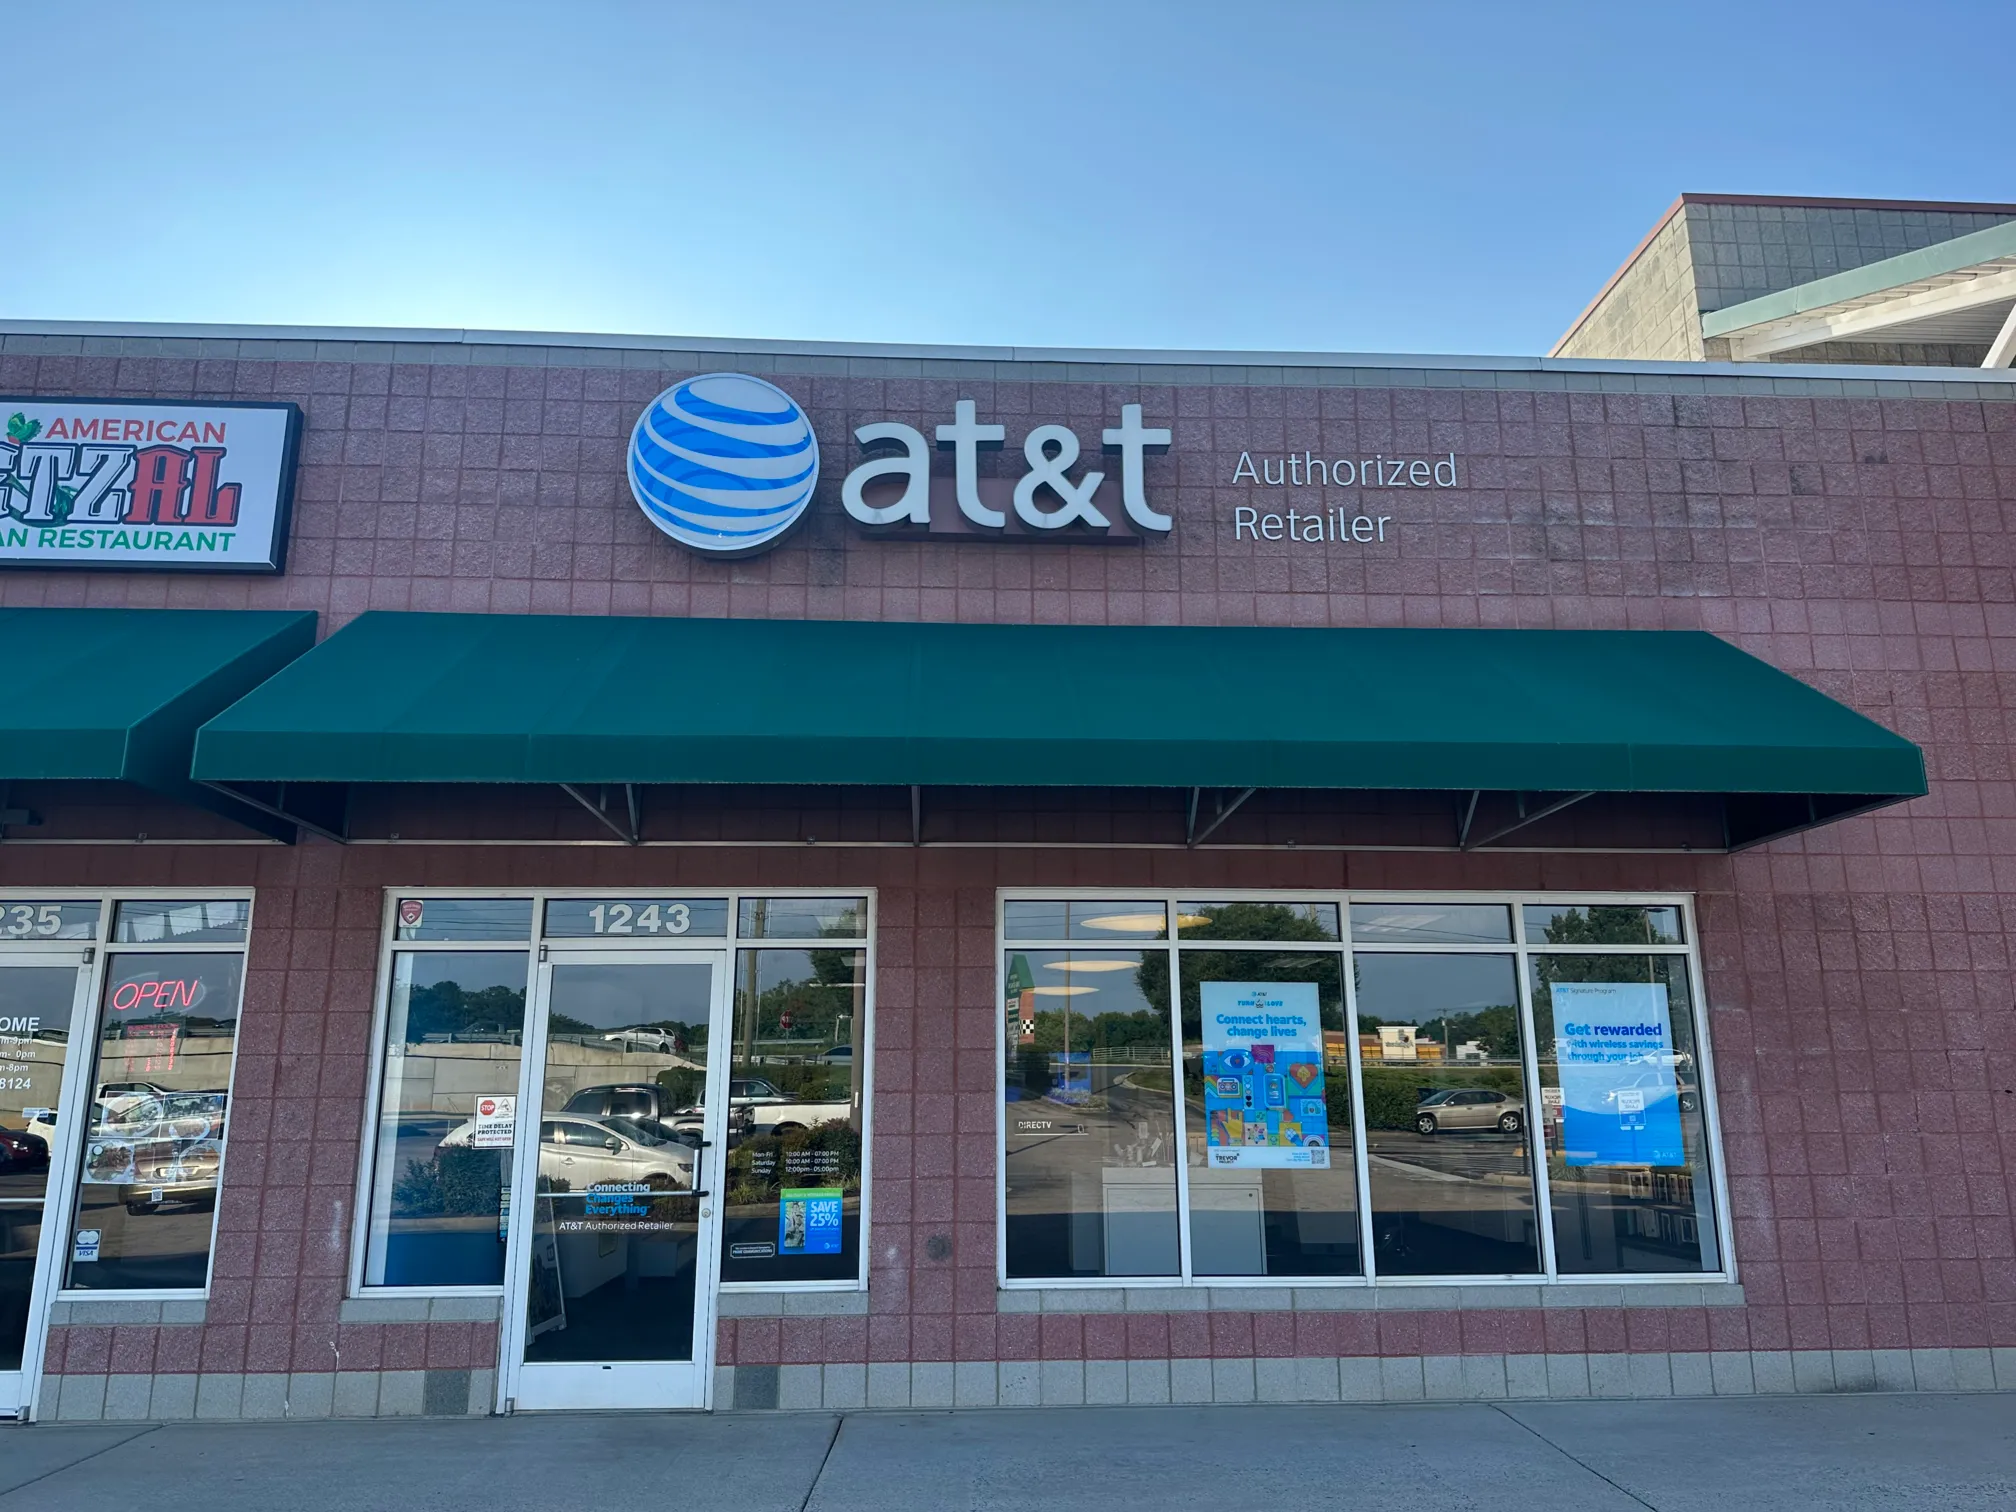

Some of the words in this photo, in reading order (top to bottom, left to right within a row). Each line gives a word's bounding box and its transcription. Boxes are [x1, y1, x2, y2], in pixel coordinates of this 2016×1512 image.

[45, 417, 227, 443] AMERICAN
[1232, 450, 1457, 487] Authorized
[1235, 506, 1392, 543] Retailer
[38, 528, 236, 552] RESTAURANT
[0, 905, 62, 935] 35
[589, 903, 691, 934] 1243
[113, 980, 198, 1010] OPEN
[1216, 1013, 1264, 1025] Connect
[1265, 1013, 1307, 1027] hearts,
[1226, 1025, 1269, 1039] change
[1270, 1025, 1297, 1037] lives
[1564, 1022, 1592, 1036] Get
[1594, 1022, 1662, 1036] rewarded
[1589, 1039, 1627, 1049] wireless
[1628, 1040, 1664, 1050] savings
[1568, 1051, 1605, 1062] through
[1605, 1052, 1628, 1062] your
[1018, 1121, 1052, 1129] DIRECTV
[587, 1182, 650, 1193] Connecting
[586, 1193, 634, 1206] Changes
[585, 1204, 648, 1217] Everything
[810, 1201, 838, 1213] SAVE
[559, 1221, 583, 1231] AT&T
[585, 1221, 637, 1230] Authorized
[638, 1220, 674, 1230] Retailer
[810, 1212, 839, 1227] 25%
